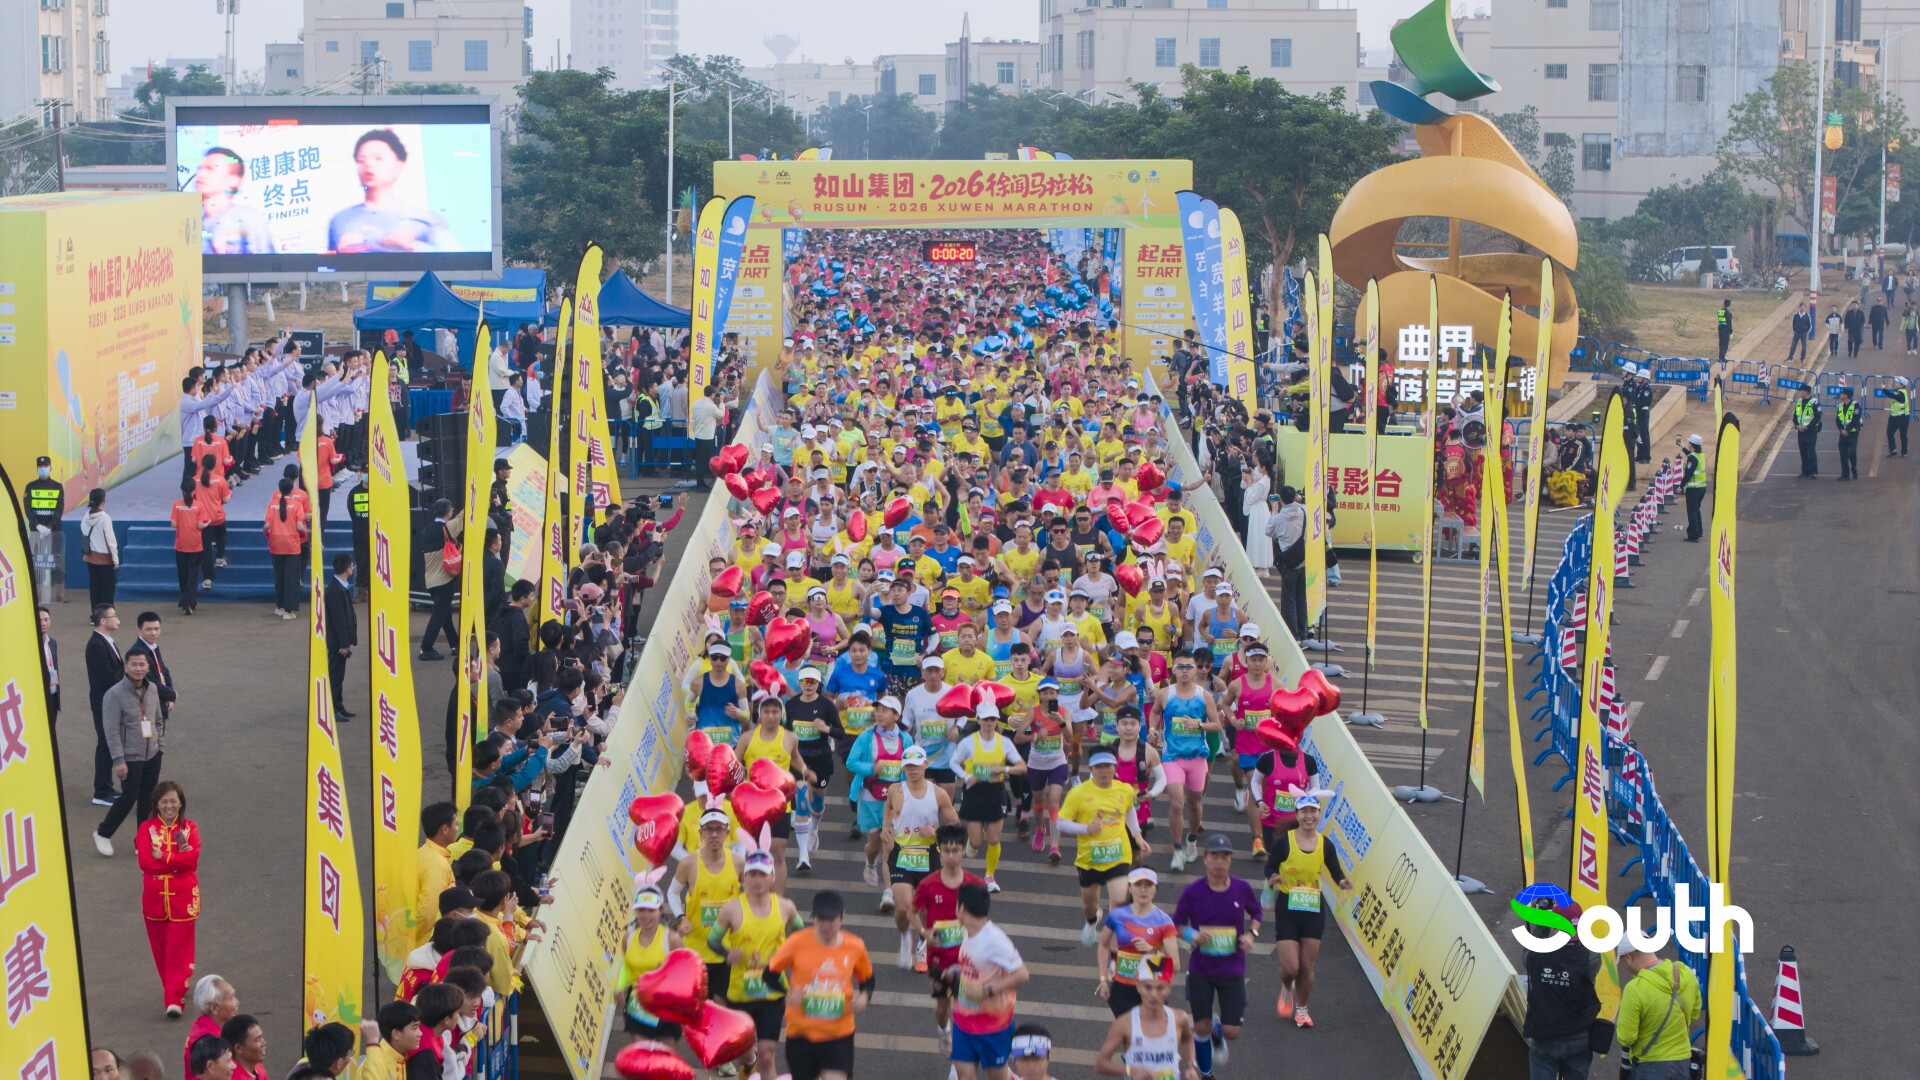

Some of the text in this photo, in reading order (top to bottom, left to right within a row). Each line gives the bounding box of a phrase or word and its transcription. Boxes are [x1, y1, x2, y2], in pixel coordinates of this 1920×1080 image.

[249, 146, 322, 182] 健康跑
[263, 178, 311, 208] 终点
[268, 207, 309, 221] FINISH
[813, 203, 1093, 212] RUSUN 2026 XUWEN MARATHON
[932, 248, 973, 260] 0:00:20
[1137, 244, 1183, 262] 起点
[1137, 266, 1183, 278] START
[88, 310, 108, 328] RUSUN
[1399, 324, 1475, 363] 曲界
[374, 520, 398, 833] 如山集团
[1093, 843, 1120, 855] A1201
[900, 854, 927, 864] A1114
[1292, 894, 1318, 904] A2068
